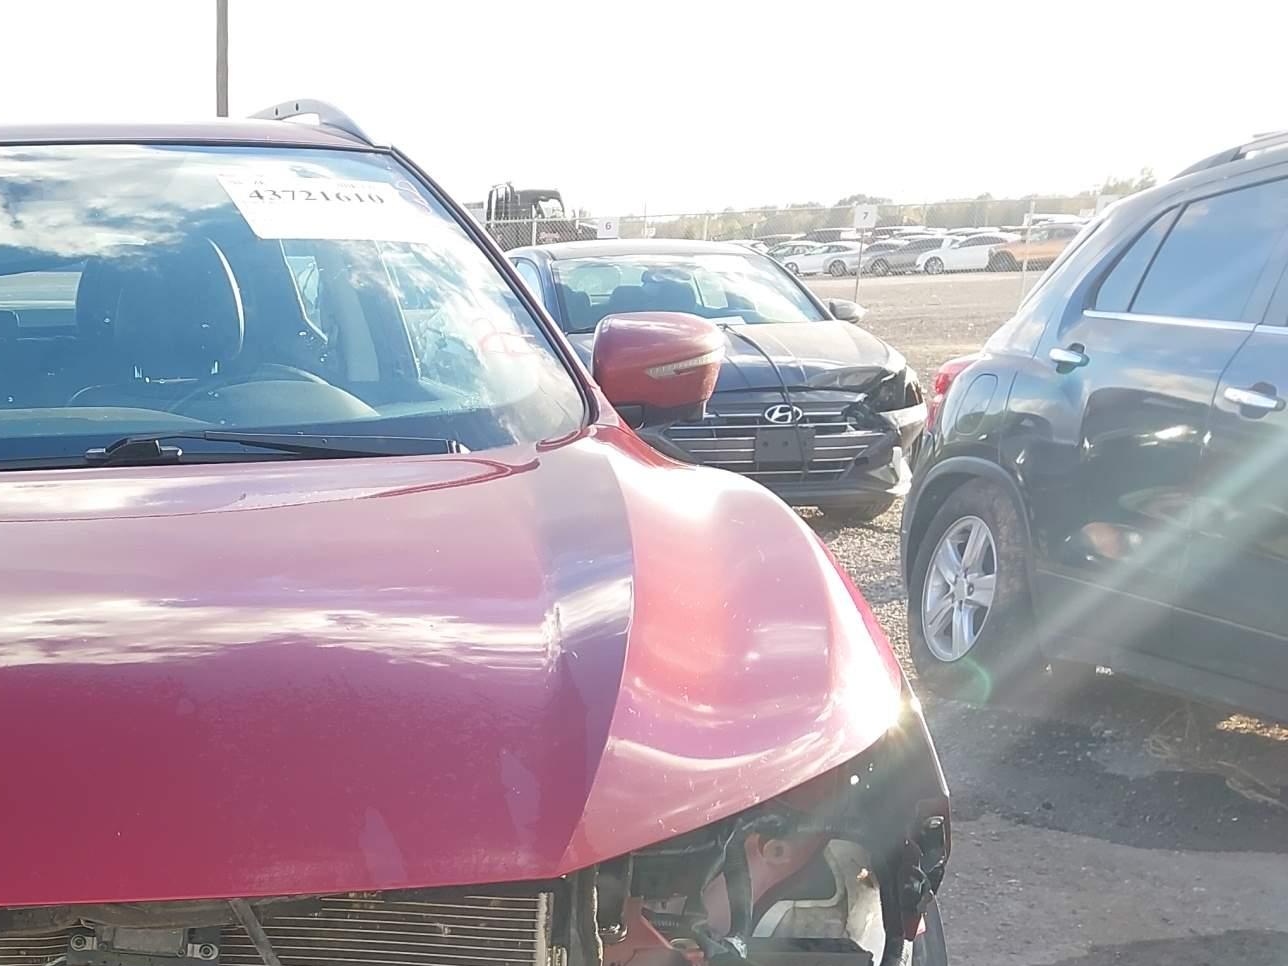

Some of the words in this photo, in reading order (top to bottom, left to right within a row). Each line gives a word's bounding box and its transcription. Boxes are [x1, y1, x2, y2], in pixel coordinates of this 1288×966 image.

[249, 188, 385, 204] 43721610
[863, 211, 869, 220] 7
[605, 222, 611, 230] 6
